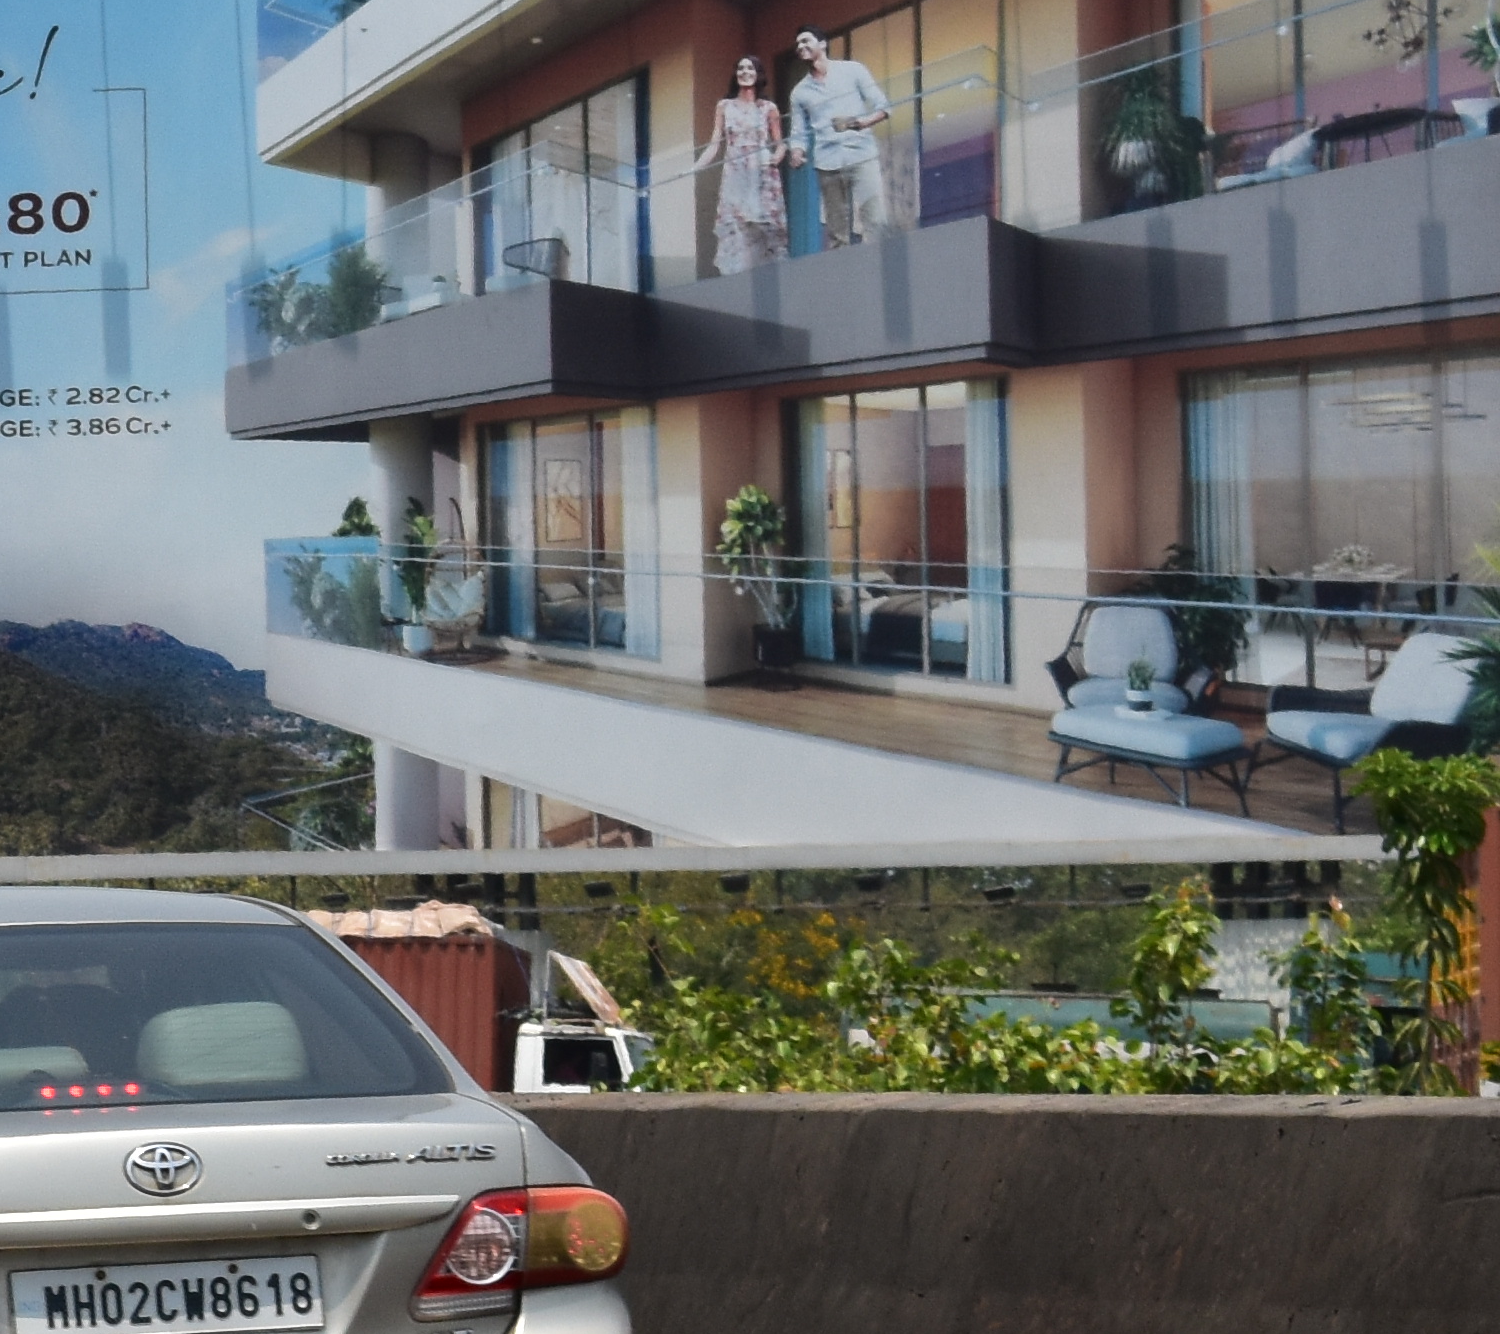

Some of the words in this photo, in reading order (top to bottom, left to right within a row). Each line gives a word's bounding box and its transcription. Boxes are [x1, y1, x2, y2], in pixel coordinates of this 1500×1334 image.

[25, 248, 93, 268] PLAN
[66, 387, 121, 405] 2.82
[66, 418, 122, 436] 3.86
[44, 1272, 313, 1329] MH02CW8618
